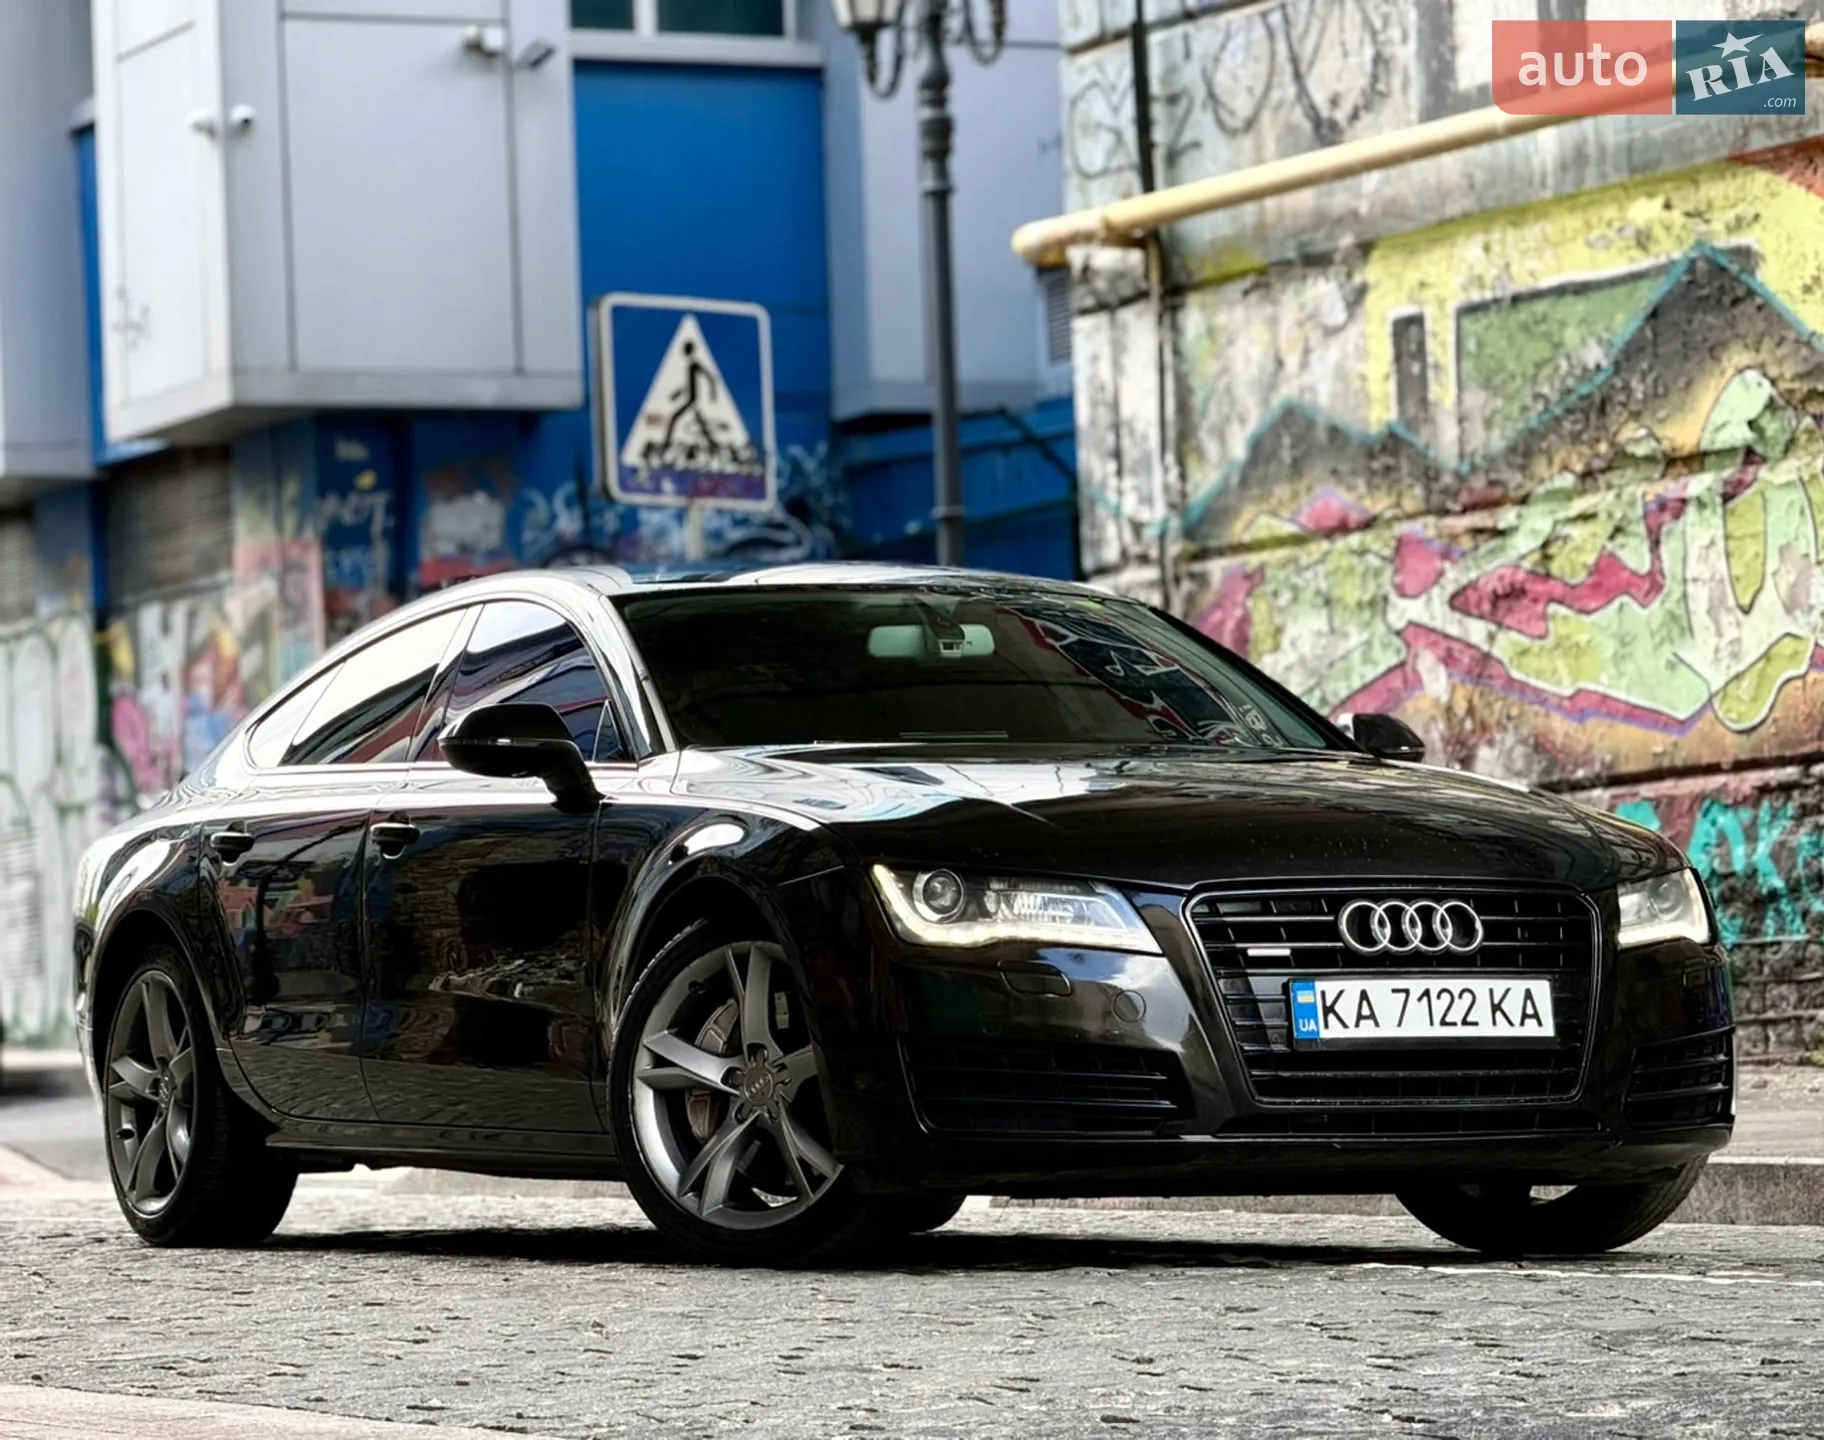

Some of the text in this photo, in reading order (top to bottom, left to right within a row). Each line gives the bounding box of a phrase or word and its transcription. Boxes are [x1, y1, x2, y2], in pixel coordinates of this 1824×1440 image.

[1320, 987, 1543, 1029] KA 7122 KA
[1299, 1019, 1318, 1032] UA
